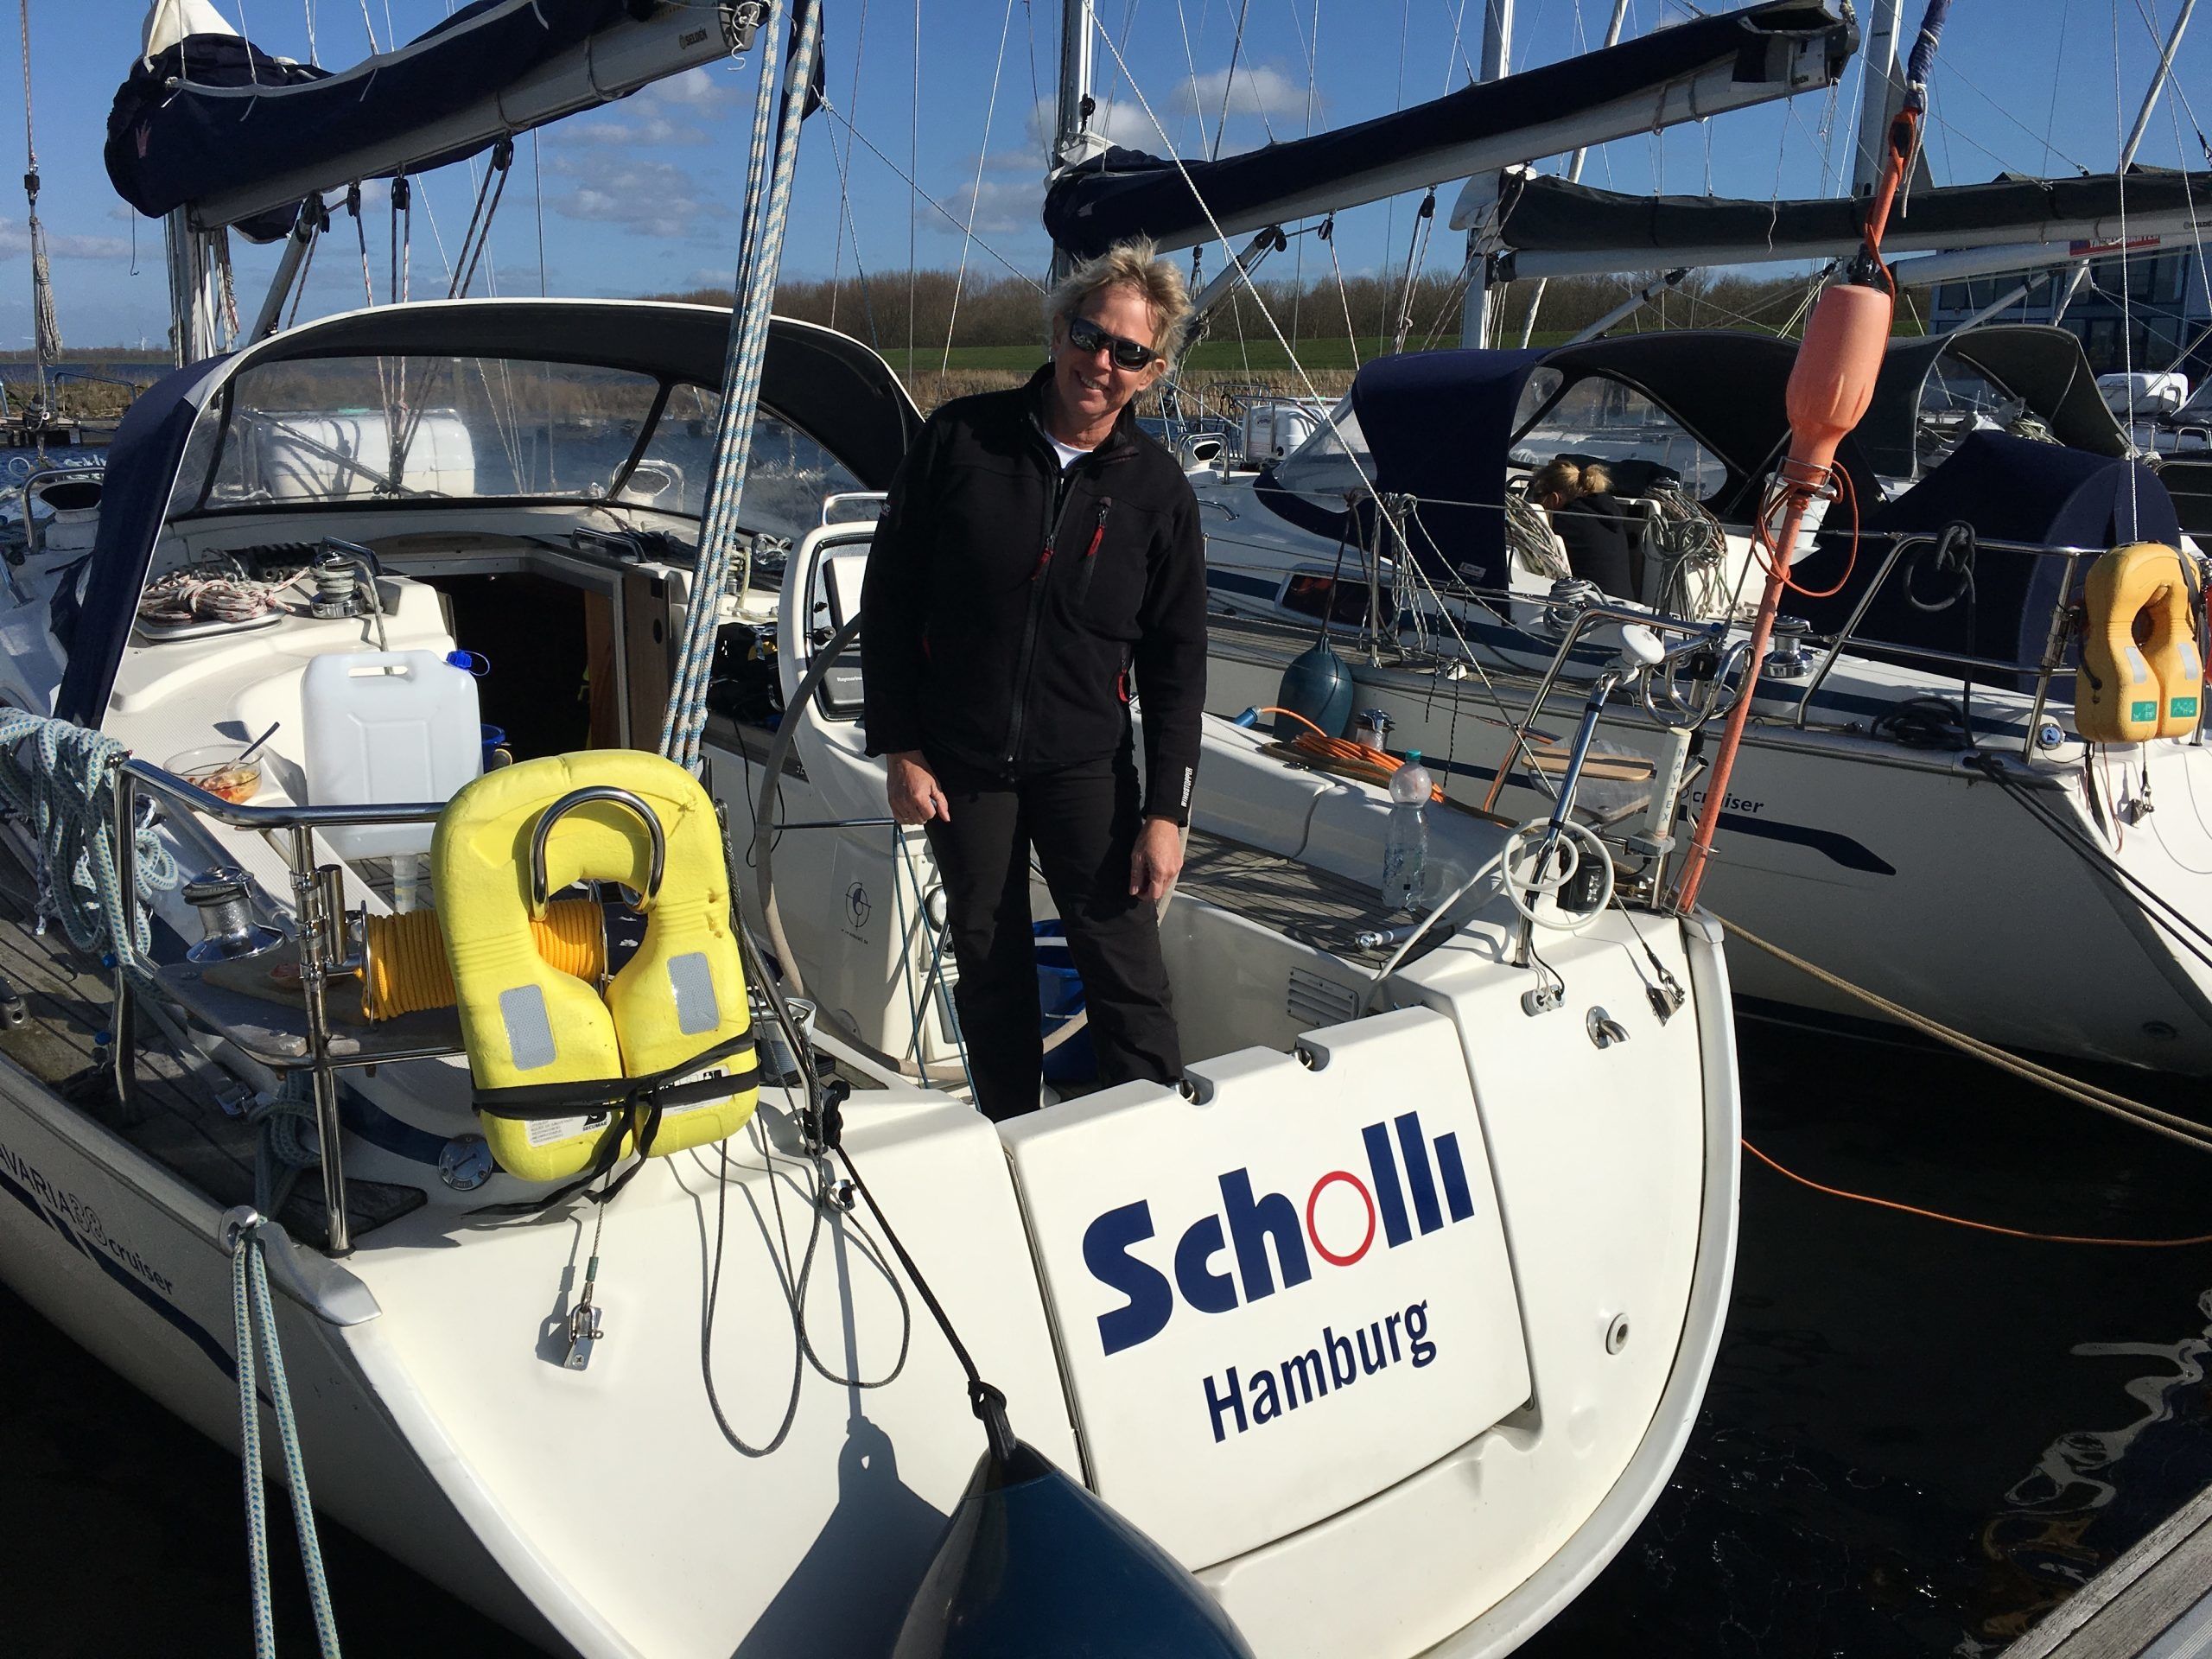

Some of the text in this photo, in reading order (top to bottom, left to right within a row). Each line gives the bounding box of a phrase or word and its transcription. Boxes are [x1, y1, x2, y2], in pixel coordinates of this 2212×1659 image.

[1180, 766, 1193, 808] WINDSTOPPER
[1662, 747, 1687, 822] NAVTEX
[1692, 791, 1764, 813] criser
[0, 1142, 77, 1224] AVARIA
[109, 1238, 173, 1295] cruiser
[1082, 1110, 1475, 1357] Scholli
[1202, 1299, 1438, 1444] Hamburg
